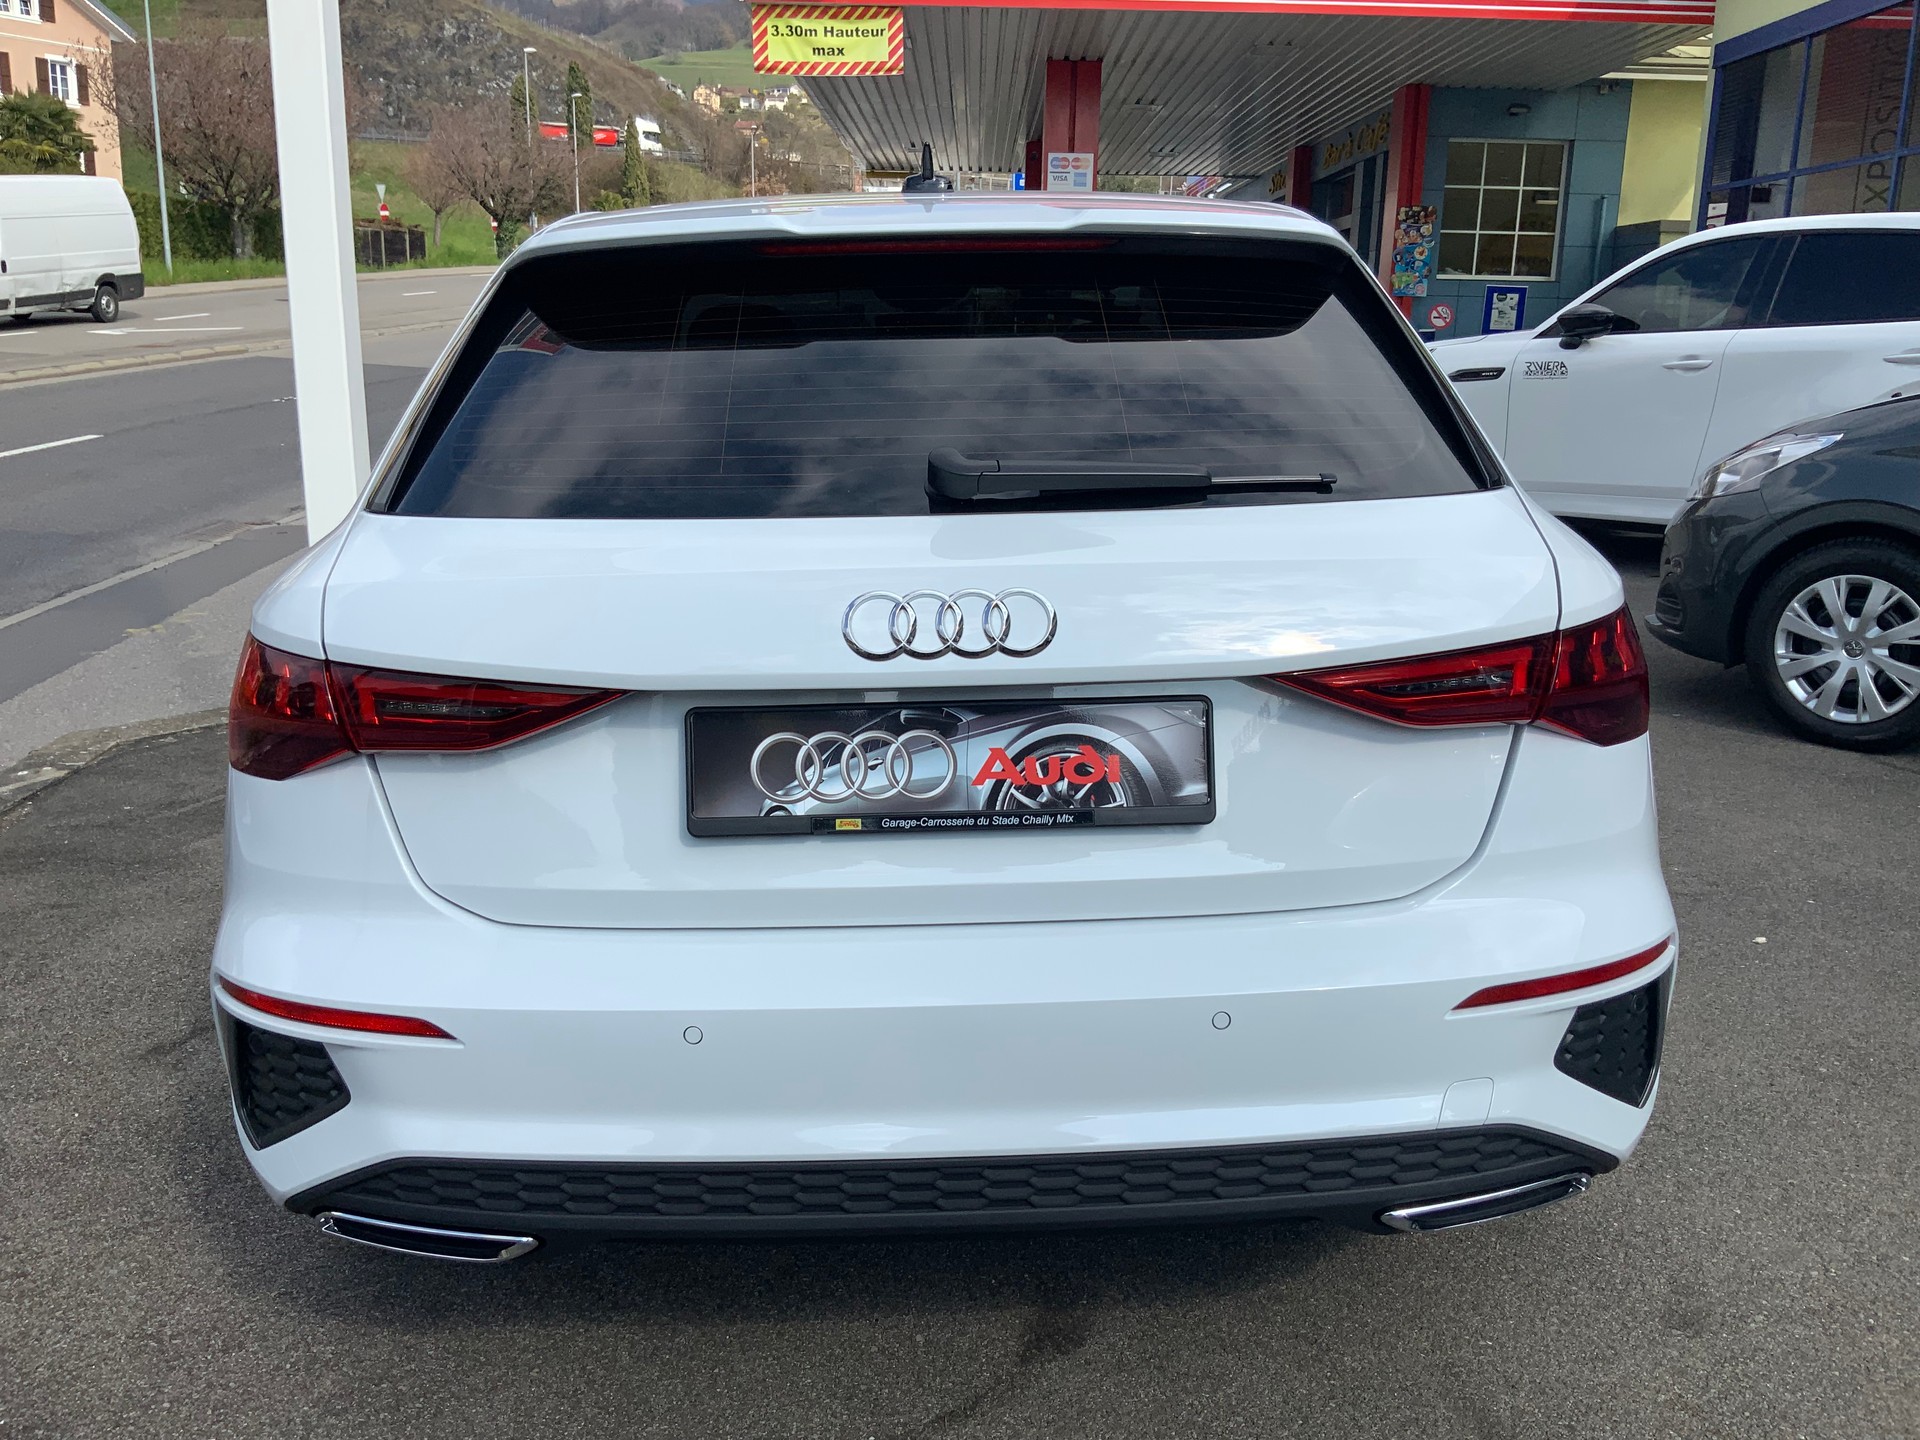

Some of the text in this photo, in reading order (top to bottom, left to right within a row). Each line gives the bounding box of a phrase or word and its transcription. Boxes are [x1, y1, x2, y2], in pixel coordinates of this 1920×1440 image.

[770, 24, 886, 38] 3.30m Hauteur
[812, 46, 846, 57] max
[1525, 361, 1568, 371] RIVIERA
[971, 744, 1121, 787] Audi
[881, 814, 1075, 828] Garage-Carrosserie du Stade Chailly Mtx
